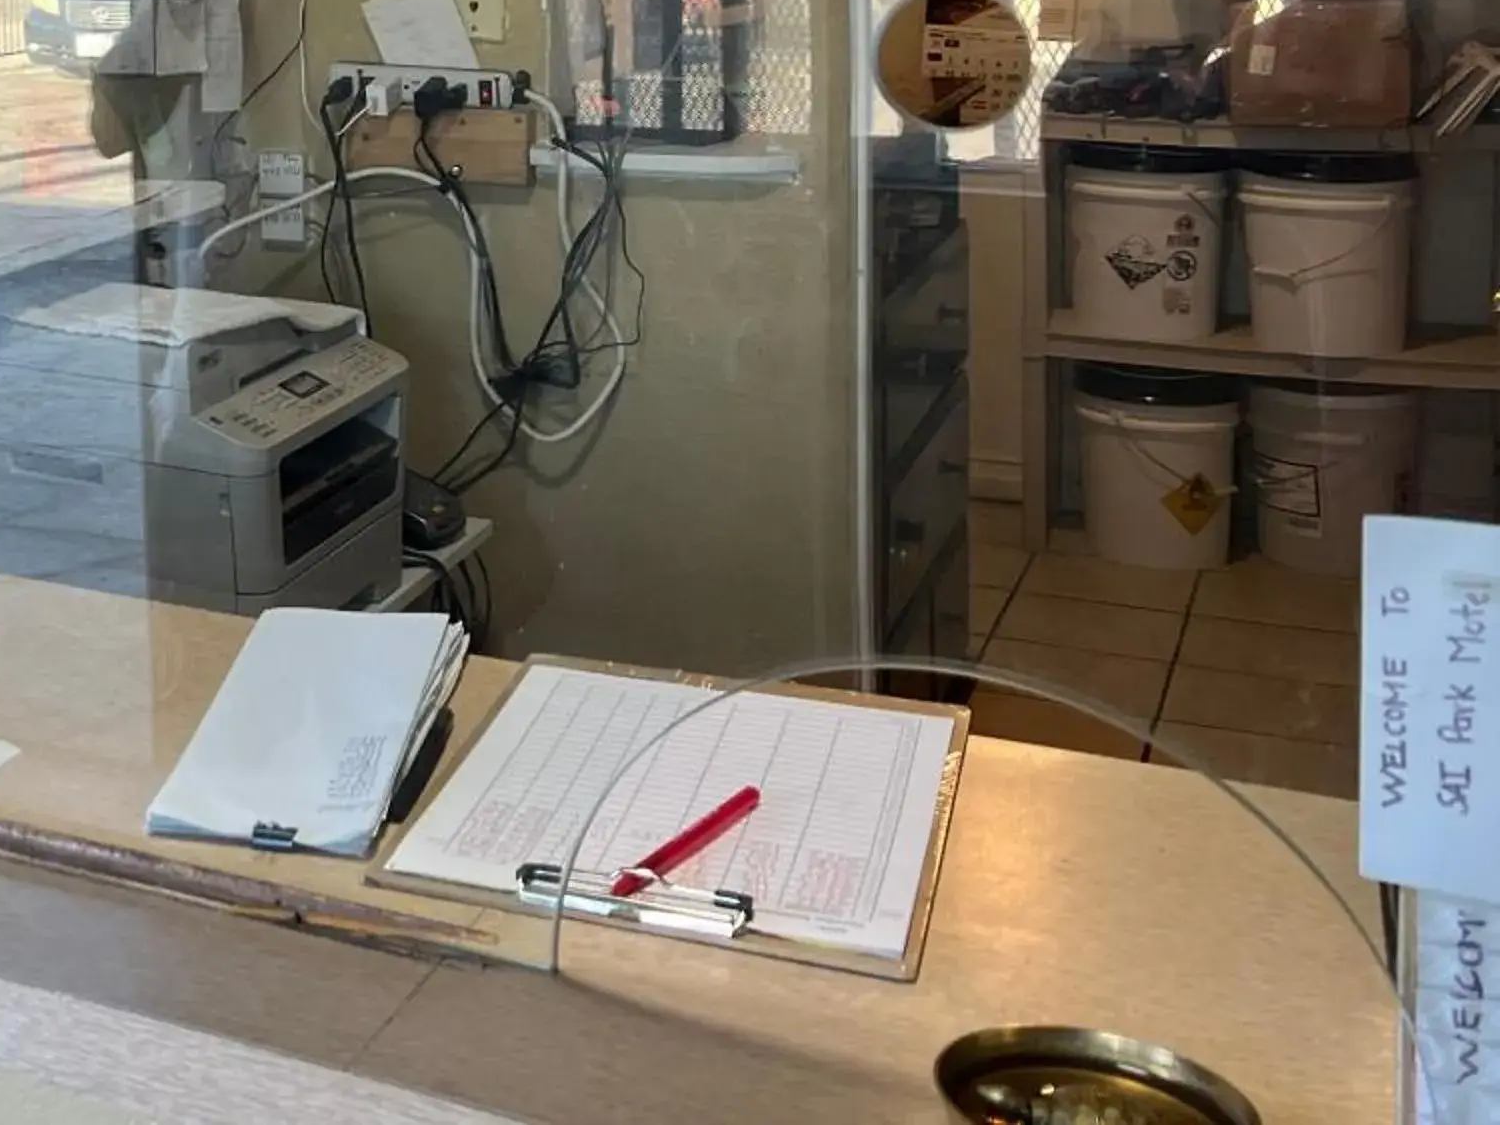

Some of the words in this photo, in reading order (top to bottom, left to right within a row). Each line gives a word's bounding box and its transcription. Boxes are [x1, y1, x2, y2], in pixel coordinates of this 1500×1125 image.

[1446, 580, 1493, 663] Motel
[1380, 655, 1408, 809] WELCOME
[1436, 684, 1477, 744] Park
[1436, 759, 1473, 817] SAI
[1451, 908, 1488, 1086] WELCOM
